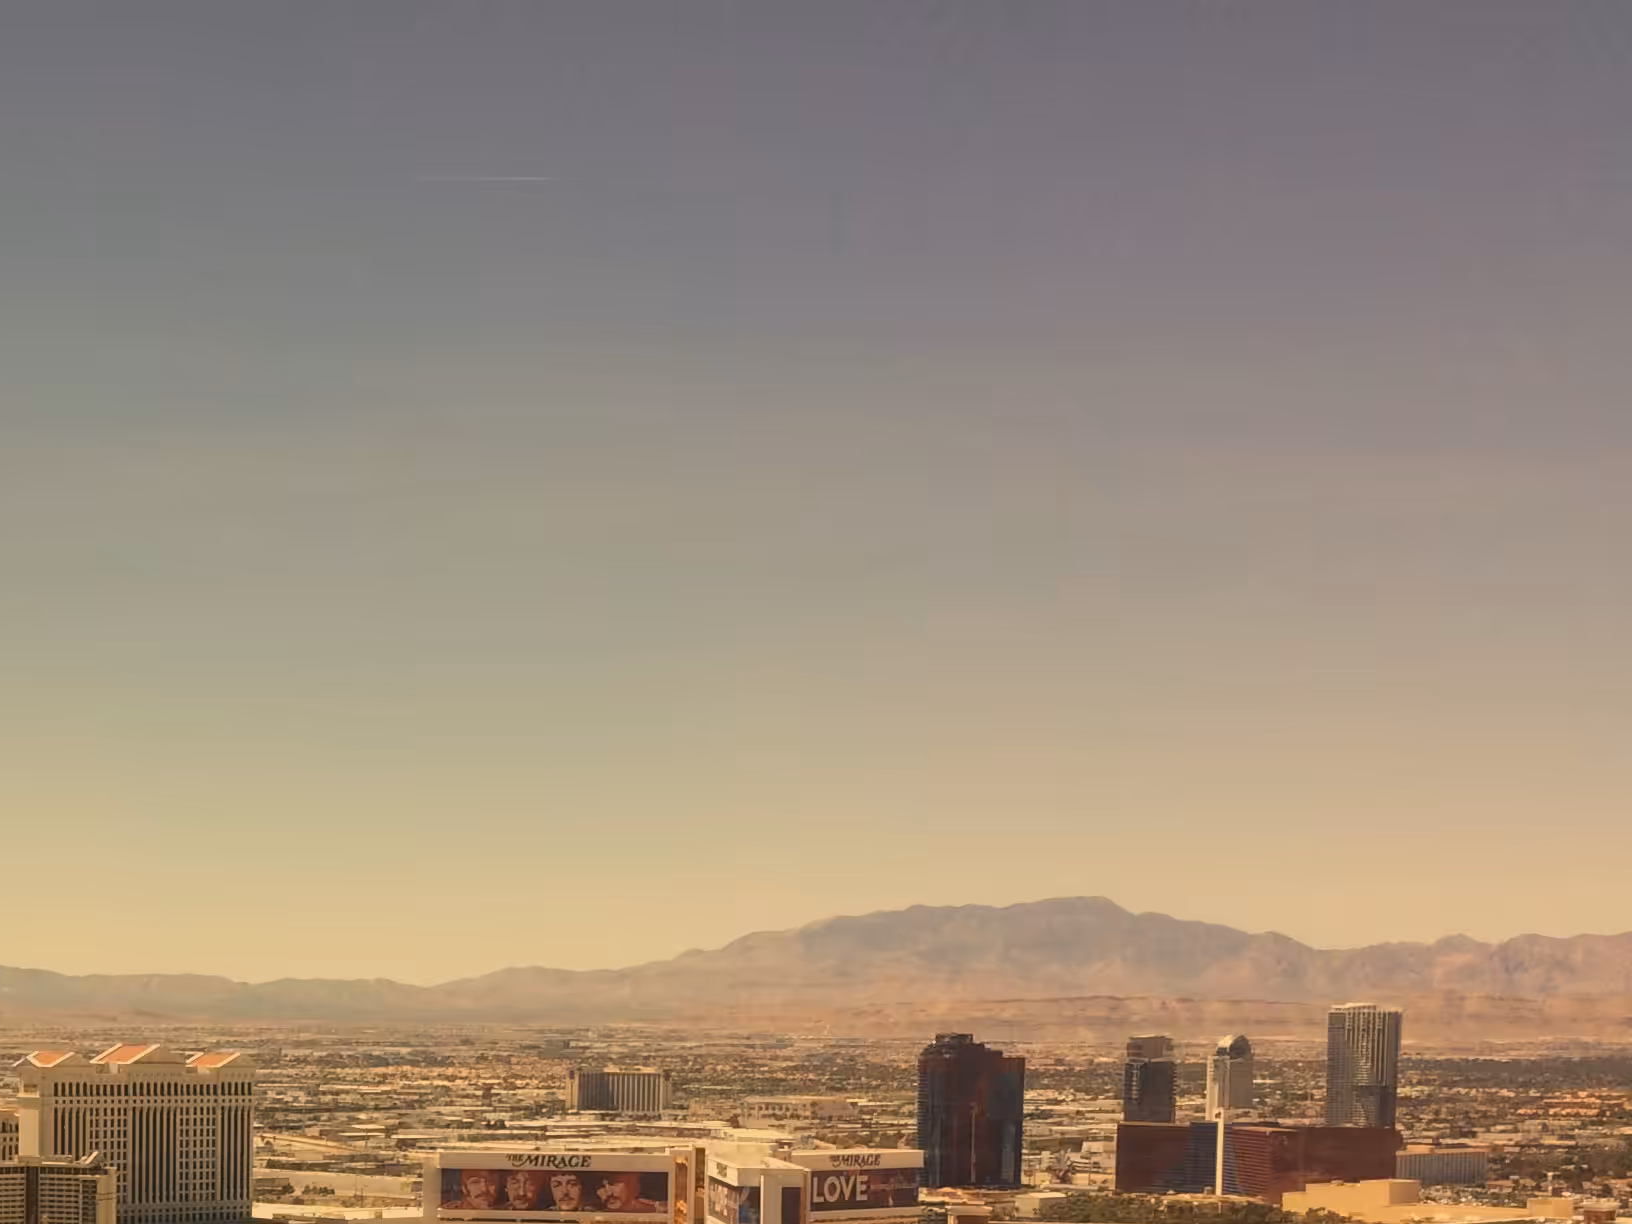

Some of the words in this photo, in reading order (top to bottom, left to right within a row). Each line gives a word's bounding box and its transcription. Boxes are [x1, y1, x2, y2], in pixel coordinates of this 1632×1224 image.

[513, 1153, 593, 1169] MIRAGE
[834, 1154, 881, 1168] MIRAGE
[812, 1174, 869, 1204] LOVE
